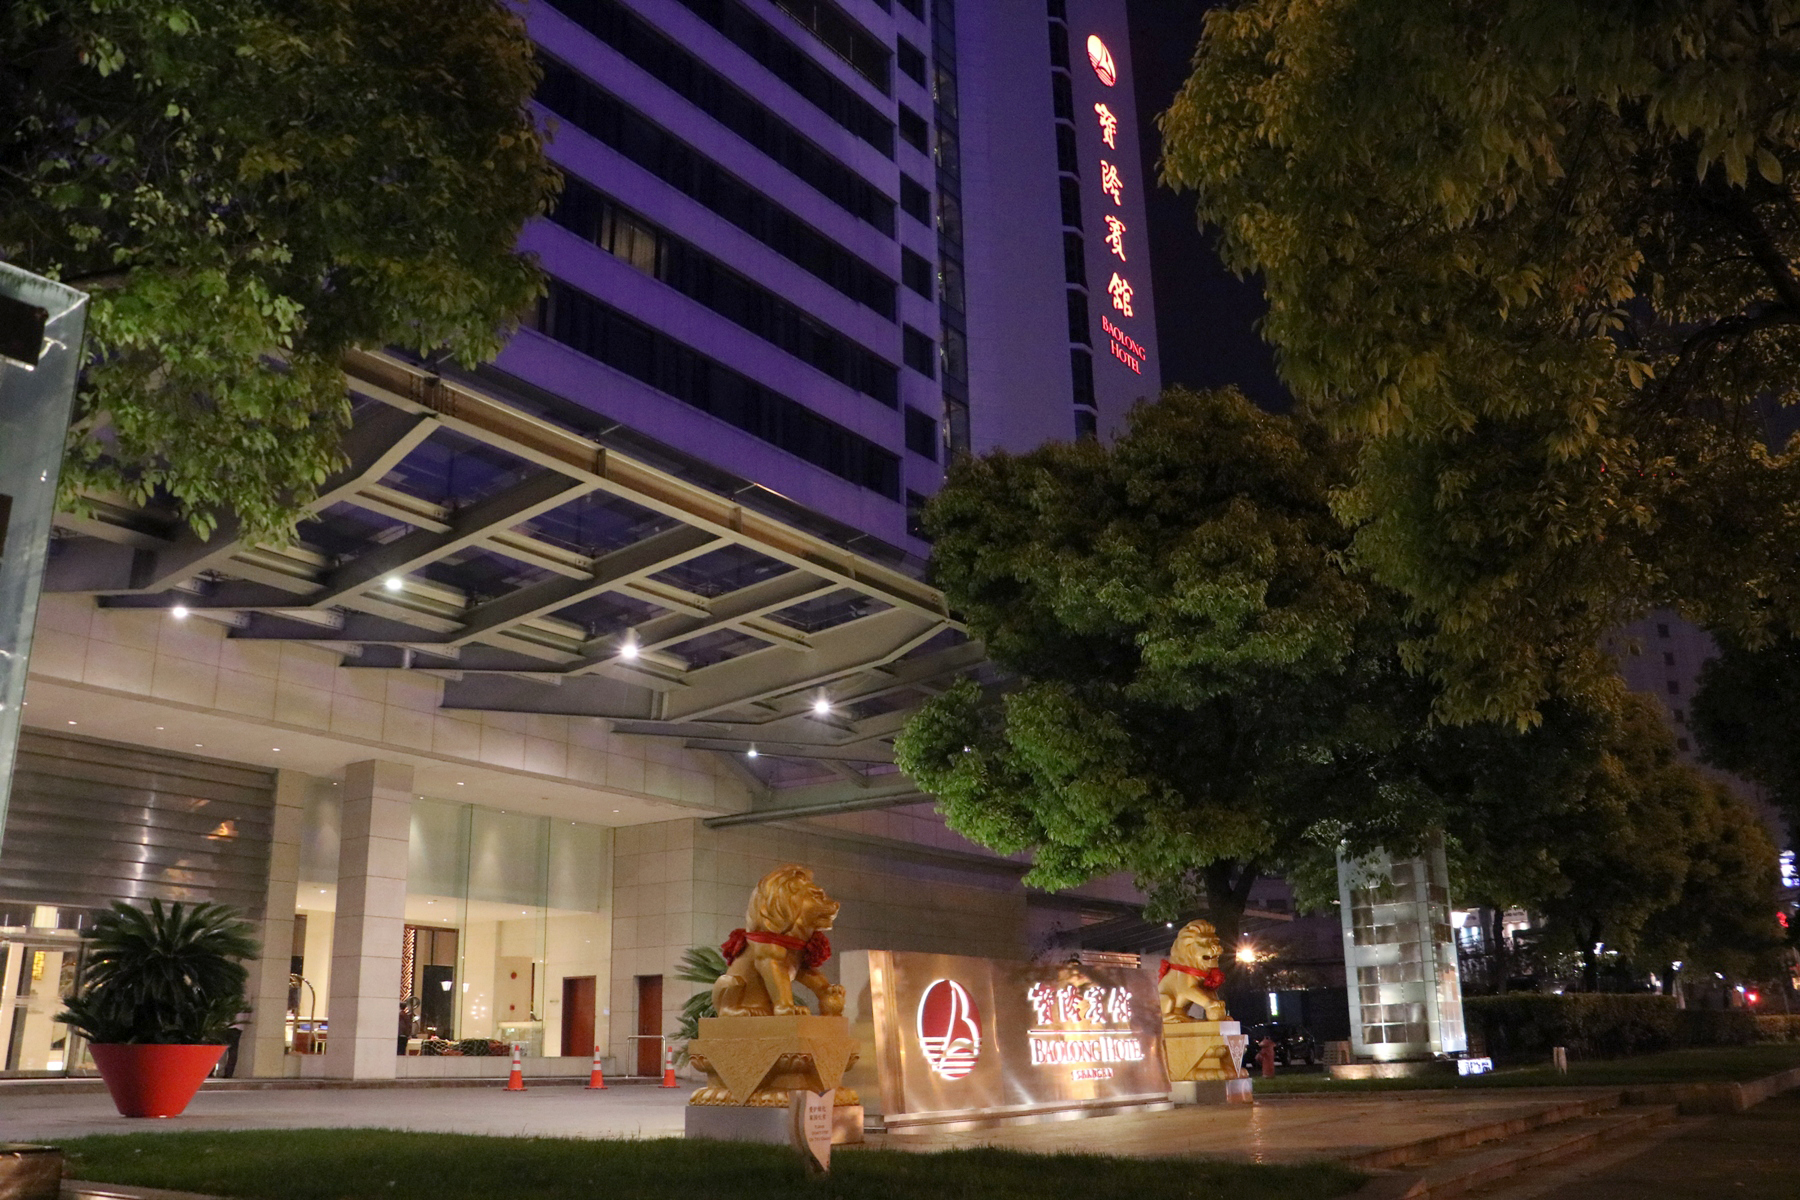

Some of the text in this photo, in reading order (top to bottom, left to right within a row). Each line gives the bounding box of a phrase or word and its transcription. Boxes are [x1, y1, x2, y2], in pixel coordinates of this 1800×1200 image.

[1101, 315, 1146, 361] BAOLONG
[1110, 339, 1142, 374] HOTEL
[1029, 1036, 1145, 1065] BAOLONG HOTEL
